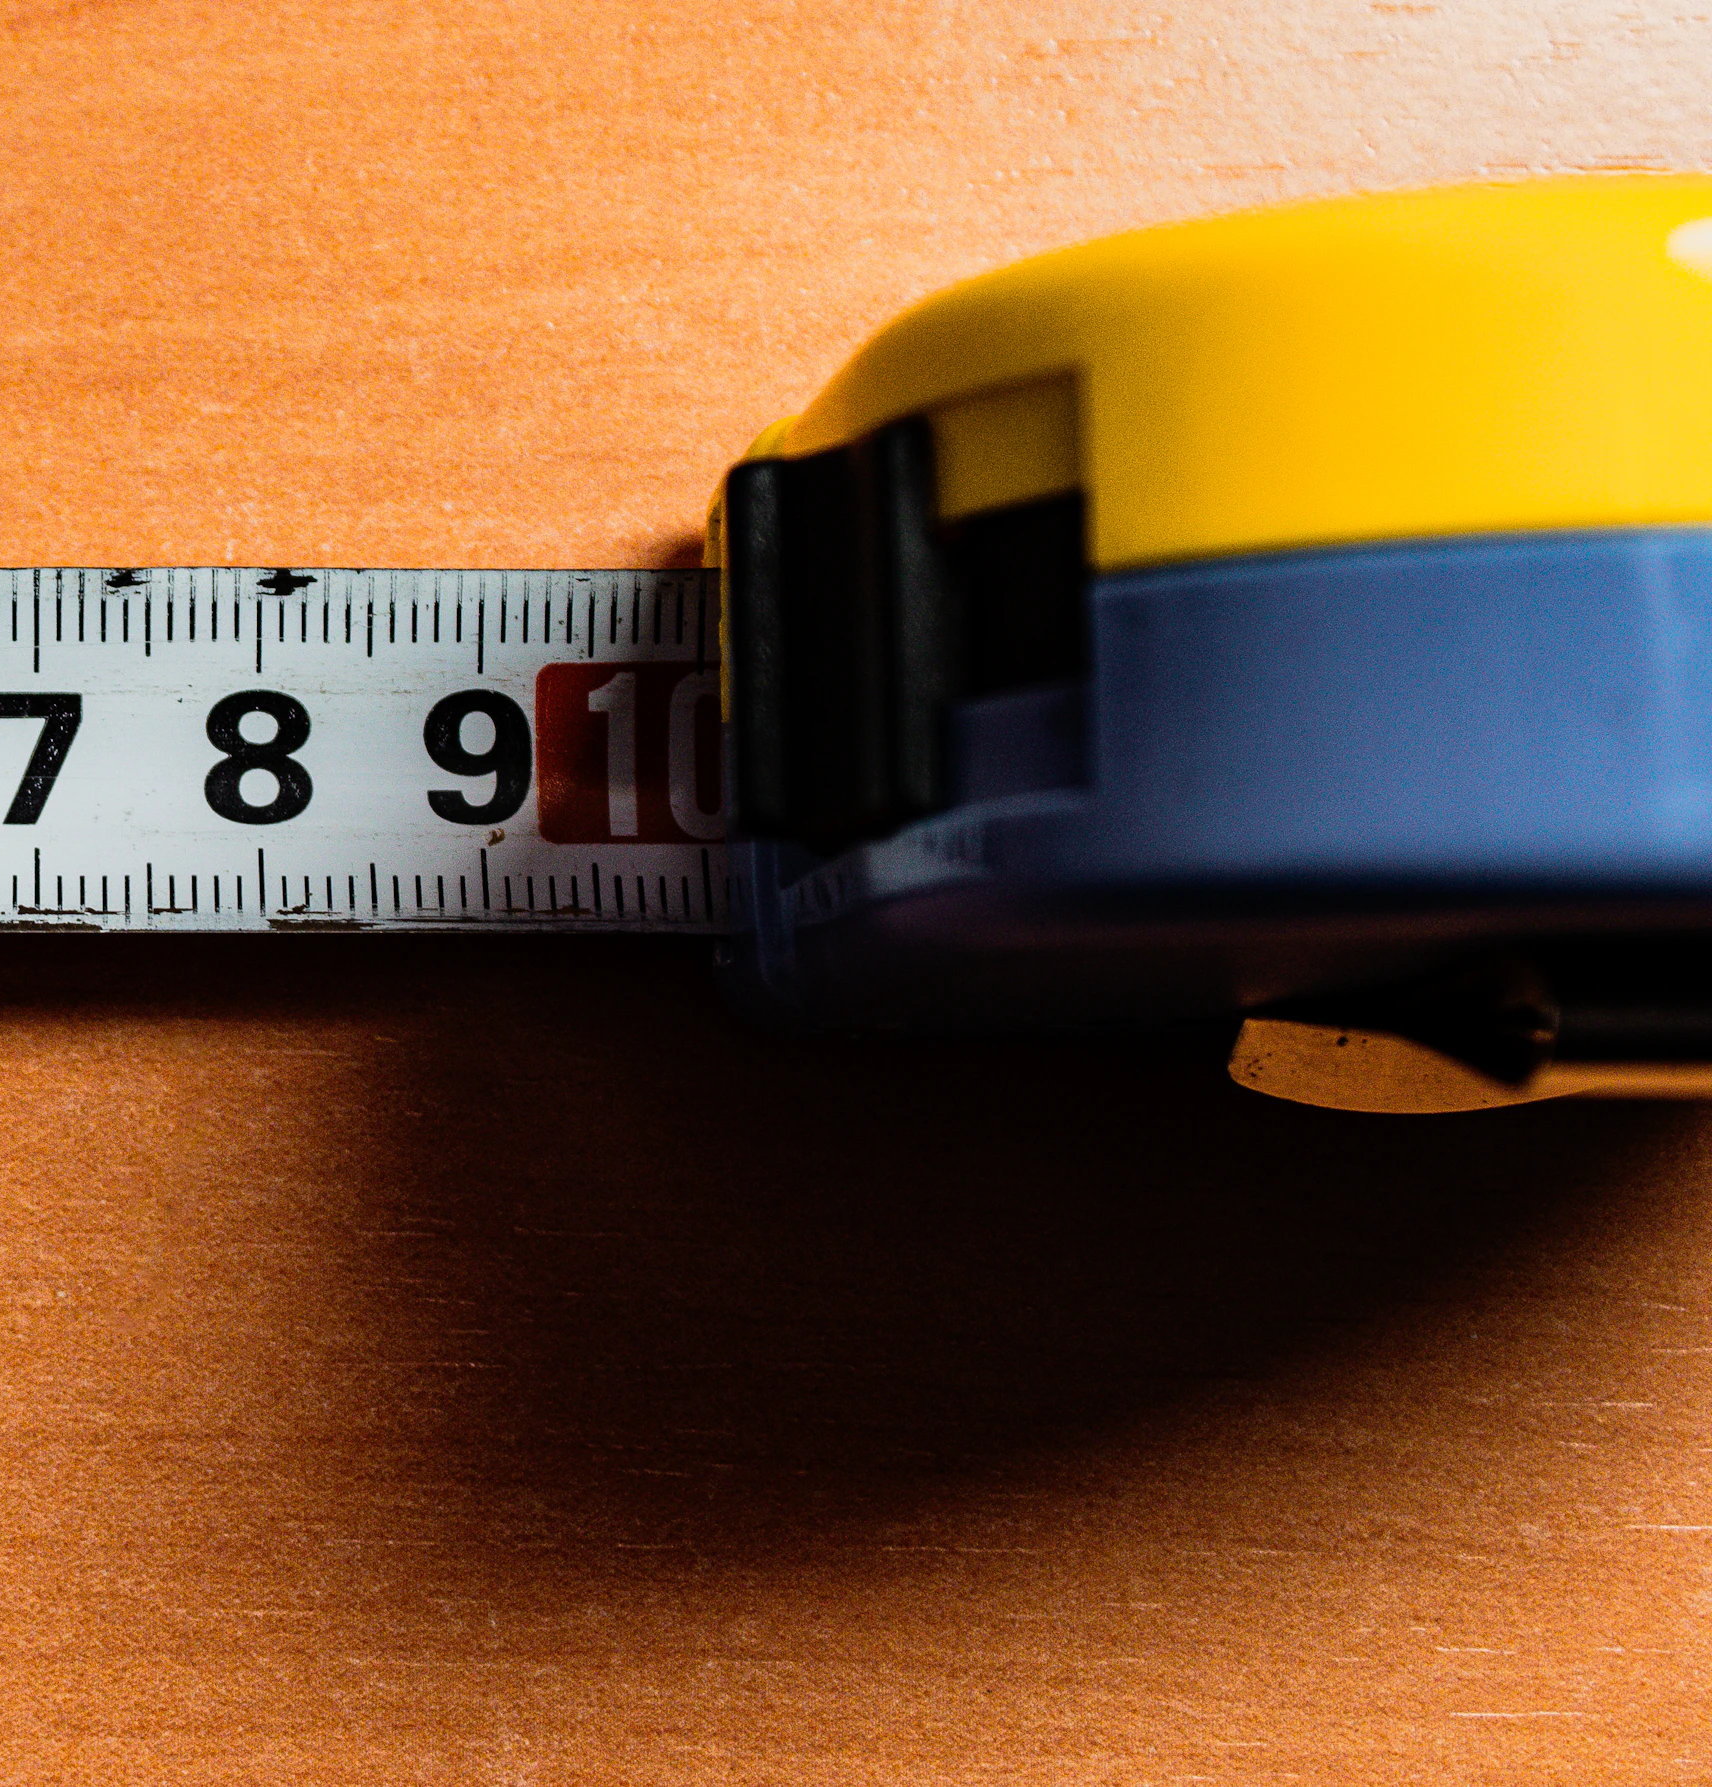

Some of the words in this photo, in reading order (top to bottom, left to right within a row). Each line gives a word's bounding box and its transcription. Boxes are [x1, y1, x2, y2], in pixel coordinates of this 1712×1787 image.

[203, 689, 313, 826] 8
[422, 688, 534, 827] 9
[587, 671, 726, 840] 10
